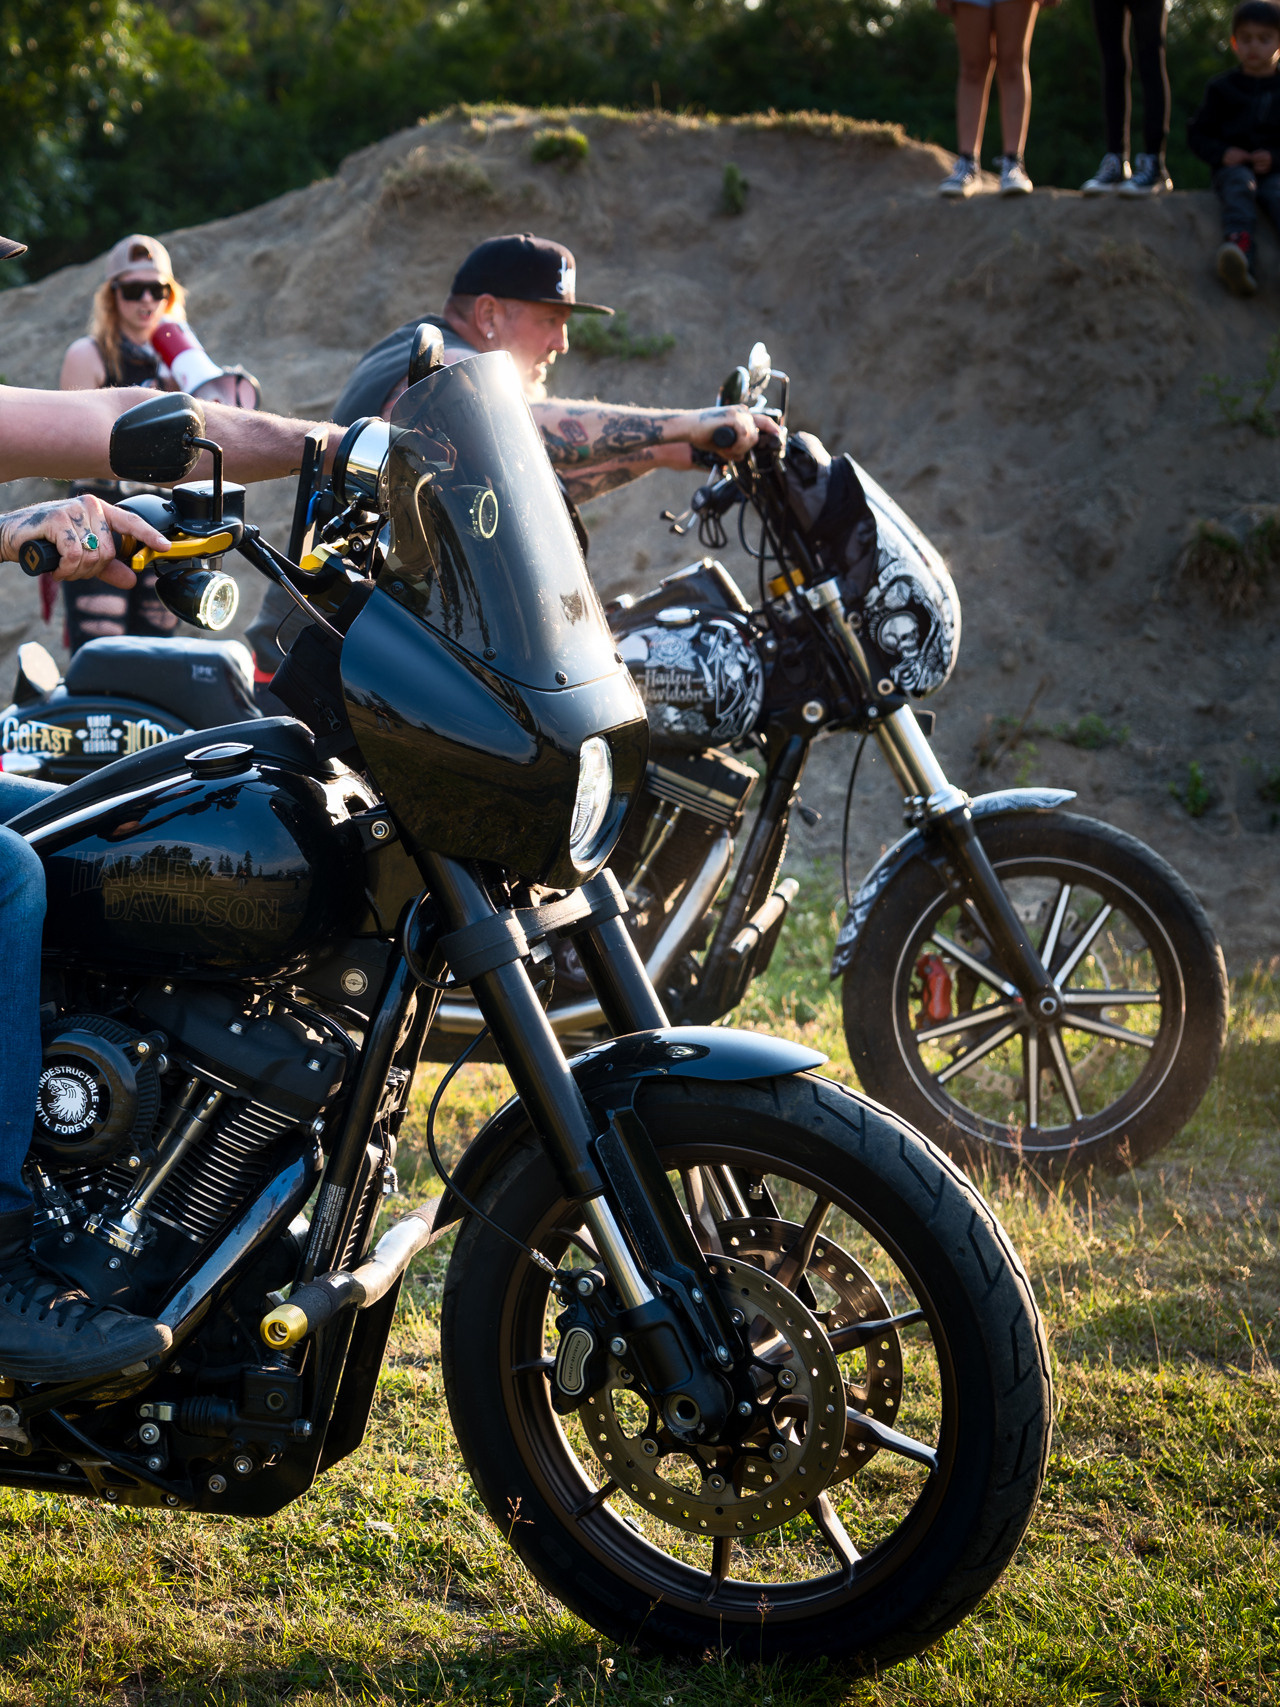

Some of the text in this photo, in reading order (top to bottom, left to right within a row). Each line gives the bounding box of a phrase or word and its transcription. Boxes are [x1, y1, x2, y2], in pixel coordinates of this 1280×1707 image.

[104, 887, 280, 931] DAVIDSON
[38, 1066, 99, 1103] INDESTRUCTIBLE
[54, 1109, 97, 1134] FOREVER
